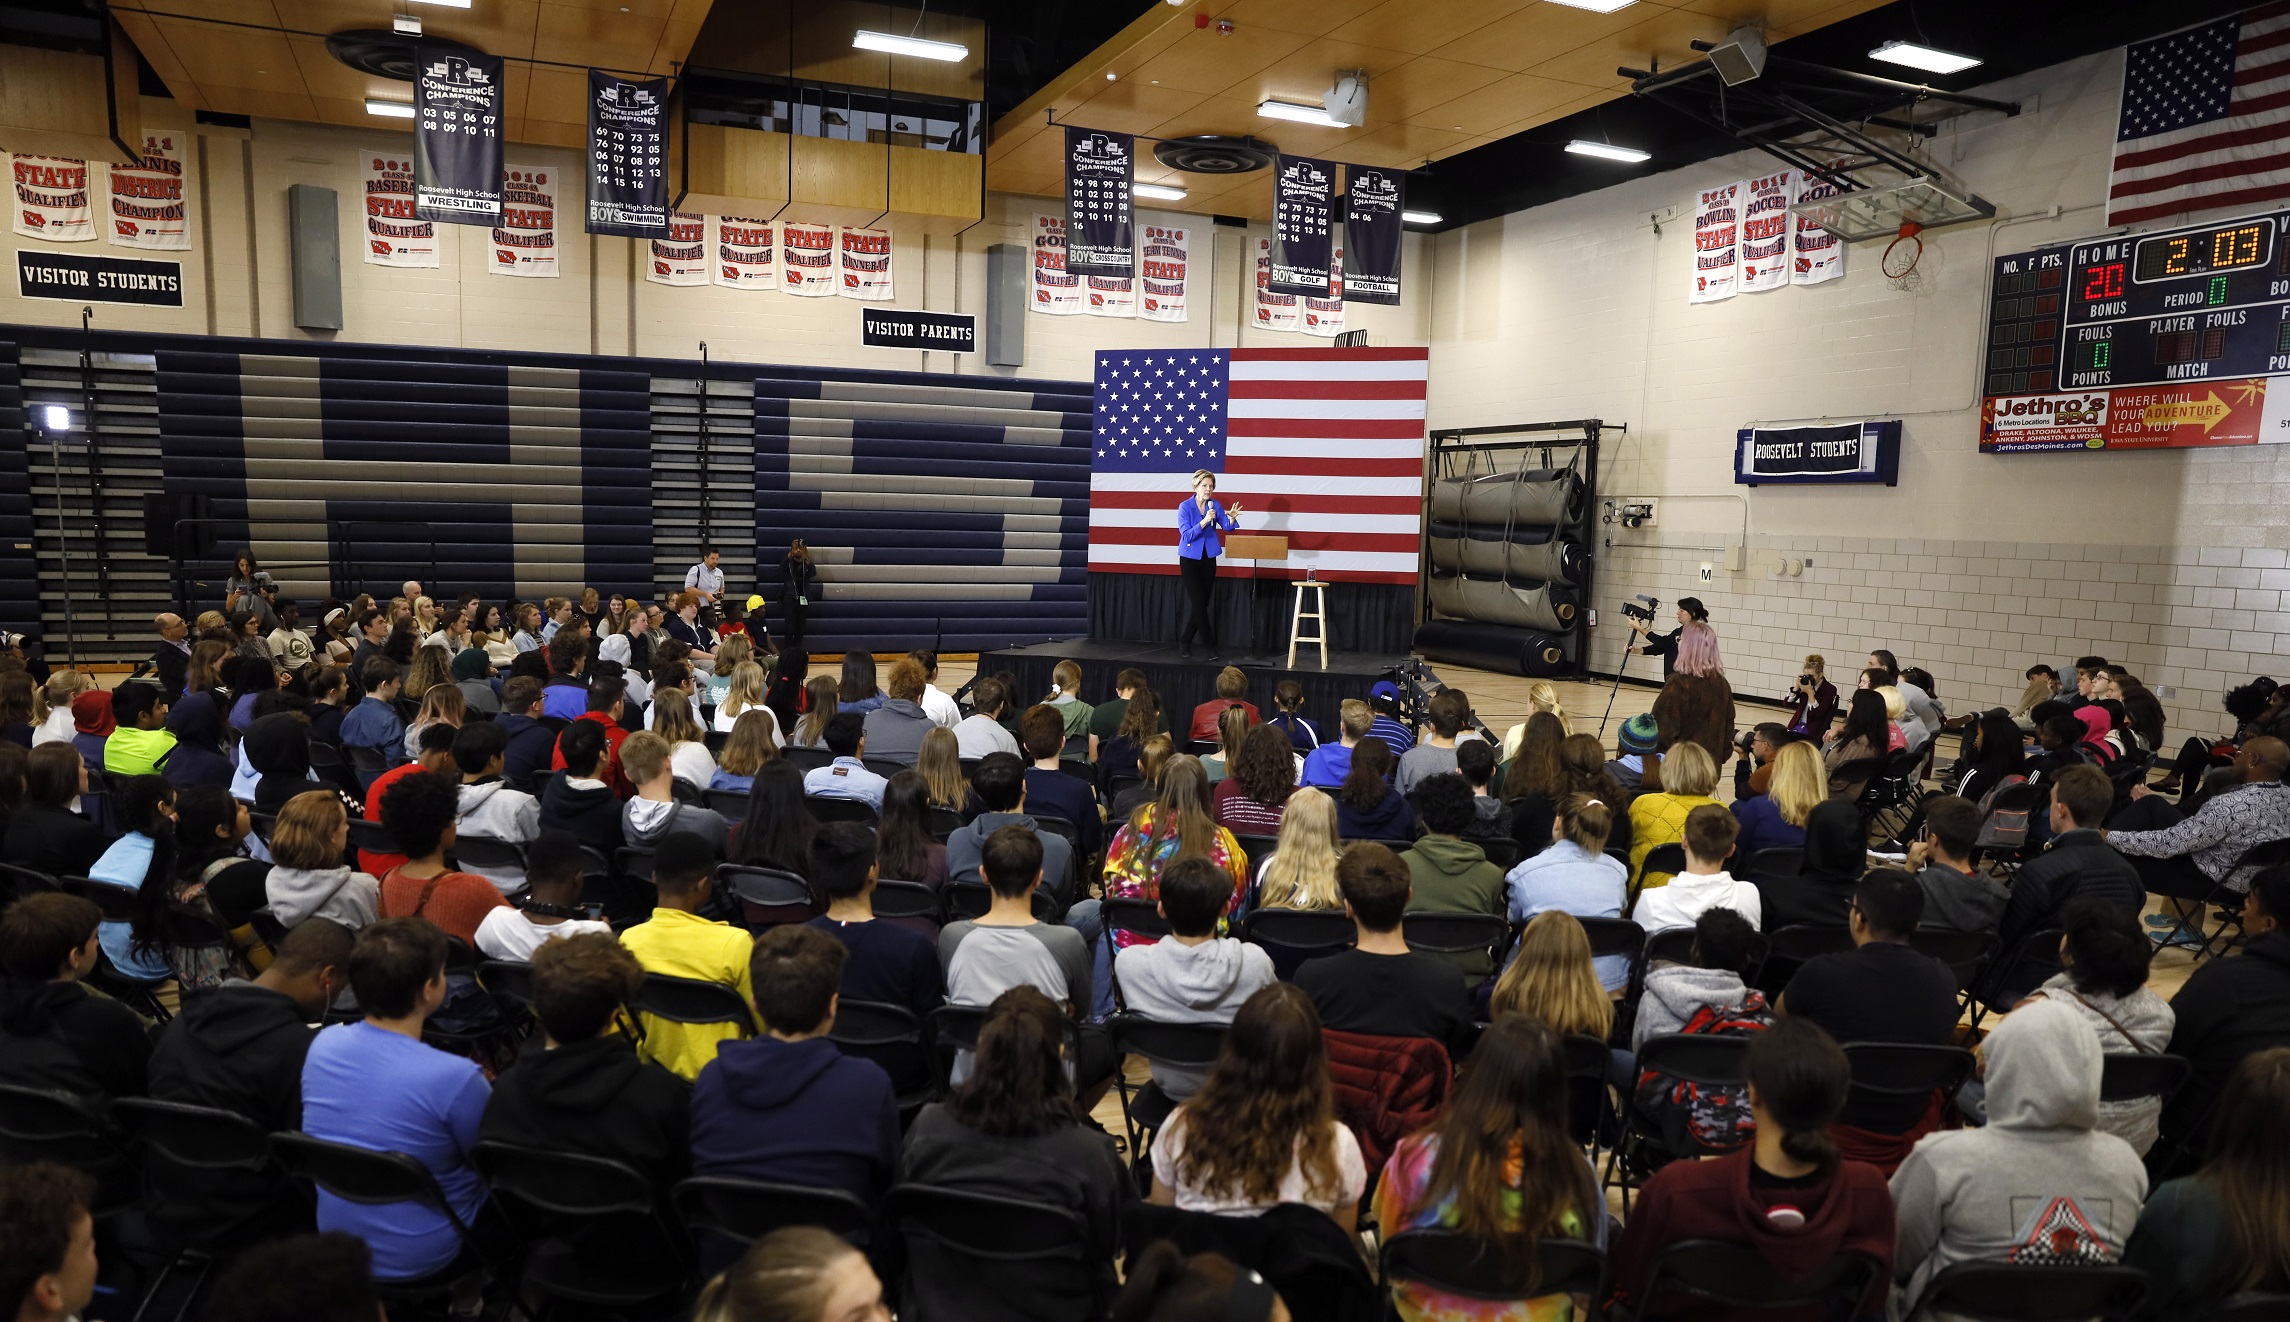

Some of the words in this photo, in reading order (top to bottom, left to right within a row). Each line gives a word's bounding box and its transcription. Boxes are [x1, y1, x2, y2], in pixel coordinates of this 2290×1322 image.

[421, 77, 495, 96] CONFERENCE
[426, 91, 490, 107] CHAMPIONS
[597, 98, 660, 116] CONFERENCE
[423, 108, 437, 117] 03
[443, 111, 456, 120] 05
[463, 113, 476, 122] 06
[483, 116, 495, 124] 07
[600, 112, 656, 125] CHAMPIONS
[423, 121, 437, 130] 08
[443, 123, 456, 132] 09
[464, 126, 476, 135] 10
[484, 128, 494, 137] 11
[596, 127, 608, 136] 69
[612, 132, 624, 140] 70
[631, 134, 643, 142] 73
[649, 134, 660, 142] 75
[596, 139, 608, 148] 76
[613, 143, 624, 152] 79
[631, 146, 643, 154] 92
[596, 151, 608, 160] 06
[614, 154, 624, 163] 07
[631, 157, 643, 165] 08
[649, 157, 660, 165] 09
[1073, 152, 1128, 165] CONFERENCE
[13, 161, 86, 189] STATE
[597, 164, 608, 172] 10
[614, 166, 624, 175] 11
[632, 169, 643, 177] 12
[649, 169, 660, 177] 13
[1076, 164, 1125, 175] CHAMPIONS
[110, 173, 182, 199] DISTRICT
[597, 176, 608, 184] 14
[614, 178, 625, 187] 15
[632, 181, 643, 189] 16
[1073, 179, 1083, 187] 96
[1088, 180, 1098, 188] 98
[1280, 178, 1329, 193] CONFERENCE
[16, 184, 87, 209] QUALIFIER
[418, 185, 454, 194] Roosevelt
[456, 188, 473, 198] High
[475, 190, 500, 199] School
[1118, 192, 1128, 200] 04
[1282, 188, 1326, 202] CHAMPIONS
[1352, 188, 1398, 201] CONFERENCE
[112, 197, 184, 220] CHAMPION
[427, 196, 491, 210] WRESTLING
[590, 200, 624, 209] Roosevelt
[625, 203, 641, 212] High
[643, 205, 665, 213] School
[1073, 200, 1083, 208] 05
[1088, 201, 1098, 209] 06
[1118, 203, 1128, 211] 08
[1354, 199, 1395, 210] CHAMPIONS
[590, 206, 620, 223] BOYS
[622, 213, 663, 224] SWIMMING
[1073, 211, 1083, 219] 09
[368, 217, 434, 238] QUALIFIER
[1073, 222, 1083, 230] 16
[1743, 212, 1787, 241] STATE
[492, 228, 554, 248] QUALIFIER
[720, 224, 773, 247] STATE
[784, 228, 833, 250] STATE
[842, 232, 890, 255] STATE
[1696, 225, 1736, 252] STATE
[652, 240, 704, 260] QUALIFIER
[720, 245, 772, 264] QUALIFIER
[1070, 243, 1097, 251] Roosevelt
[1098, 245, 1112, 253] High
[1143, 245, 1161, 257] TEAM
[1162, 246, 1186, 261] TENNIS
[1743, 236, 1786, 260] QUALIFIER
[2079, 243, 2130, 264] HOME
[2165, 227, 2259, 274] 2:03
[784, 249, 831, 267] QUALIFIER
[842, 252, 889, 272] RUNNER-UP
[1069, 250, 1095, 263] BOYS
[1095, 254, 1110, 262] CROSS
[1110, 255, 1131, 263] COUNTRY
[2003, 260, 2019, 274] NO.
[2028, 258, 2034, 270] F
[2041, 254, 2062, 268] PTS.
[1143, 259, 1185, 280] STATE
[1272, 263, 1298, 271] Roosevelt
[1298, 266, 1310, 274] High
[1311, 267, 1328, 276] School
[1272, 269, 1295, 283] BOYS
[1300, 276, 1320, 284] GOLF
[24, 266, 89, 287] VISITOR
[98, 272, 177, 291] STUDENTS
[1035, 270, 1079, 287] QUALIFIER
[1088, 275, 1132, 292] CHAMPION
[1354, 282, 1390, 291] FOOTBALL
[2085, 263, 2124, 299] 20
[1143, 279, 1184, 296] QUALIFIER
[2208, 276, 2227, 304] 0
[1257, 290, 1296, 306] QUALIFIER
[2164, 291, 2203, 307] PERIOD
[2090, 301, 2127, 318] BONUS
[2150, 317, 2195, 334] PLAYER
[2206, 310, 2247, 328] FOULS
[867, 321, 914, 337] VISITOR
[921, 324, 972, 340] PARENTS
[2078, 326, 2112, 341] FOULS
[2094, 342, 2109, 368] 0
[2072, 371, 2111, 386] POINTS
[2167, 363, 2208, 379] MATCH
[1997, 395, 2105, 416] Jethro's
[2115, 394, 2157, 407] WHERE
[2163, 392, 2193, 404] WILL
[2054, 411, 2099, 426] BBQ
[2113, 409, 2145, 421] YOUR
[2145, 405, 2221, 419] ADVENTURE
[2021, 418, 2050, 426] Locations
[2111, 422, 2141, 434] LEAD
[2147, 420, 2178, 432] YOU?
[1755, 442, 1803, 459] ROOSEVELT
[1810, 439, 1857, 458] STUDENTS
[1997, 443, 2083, 452] JethrosDesMoines.com
[1701, 569, 1711, 580] M
